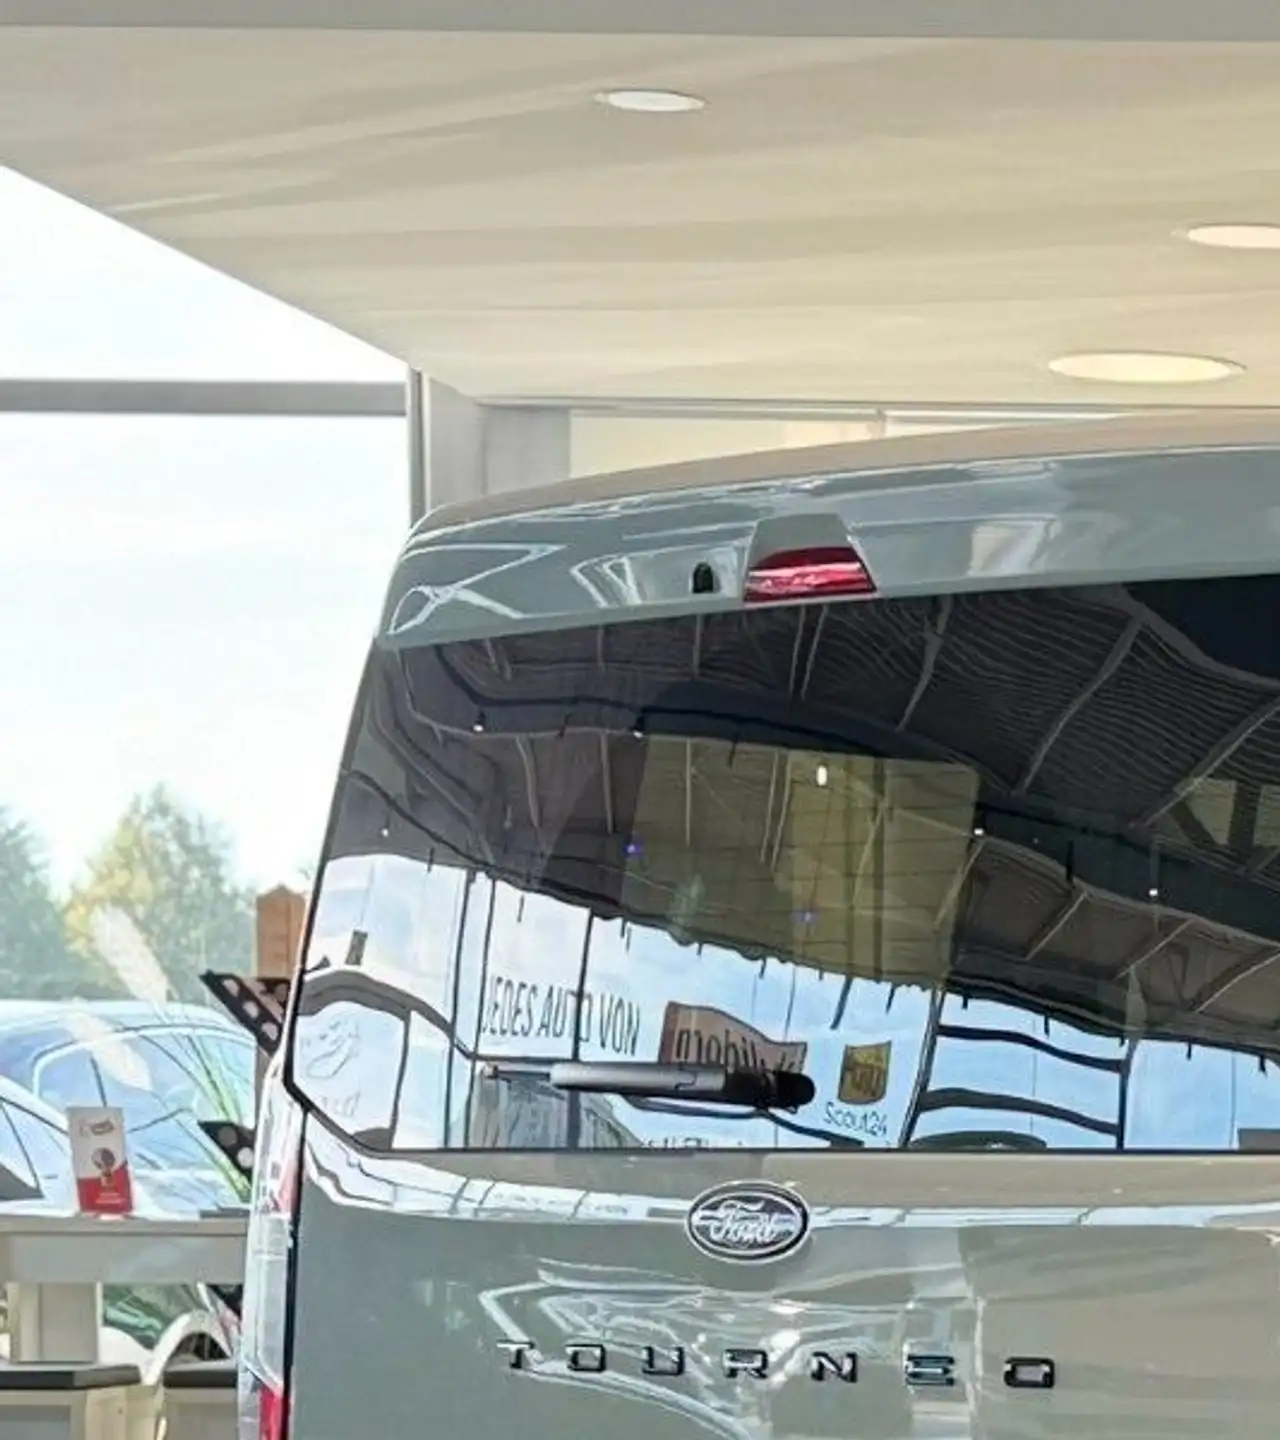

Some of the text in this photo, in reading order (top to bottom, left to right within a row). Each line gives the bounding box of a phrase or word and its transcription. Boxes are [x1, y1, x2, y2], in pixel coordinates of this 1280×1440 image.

[482, 976, 537, 1036] JEDES
[600, 994, 640, 1056] VON
[698, 1199, 779, 1244] Ford
[497, 1339, 1056, 1389] TOURNEO
